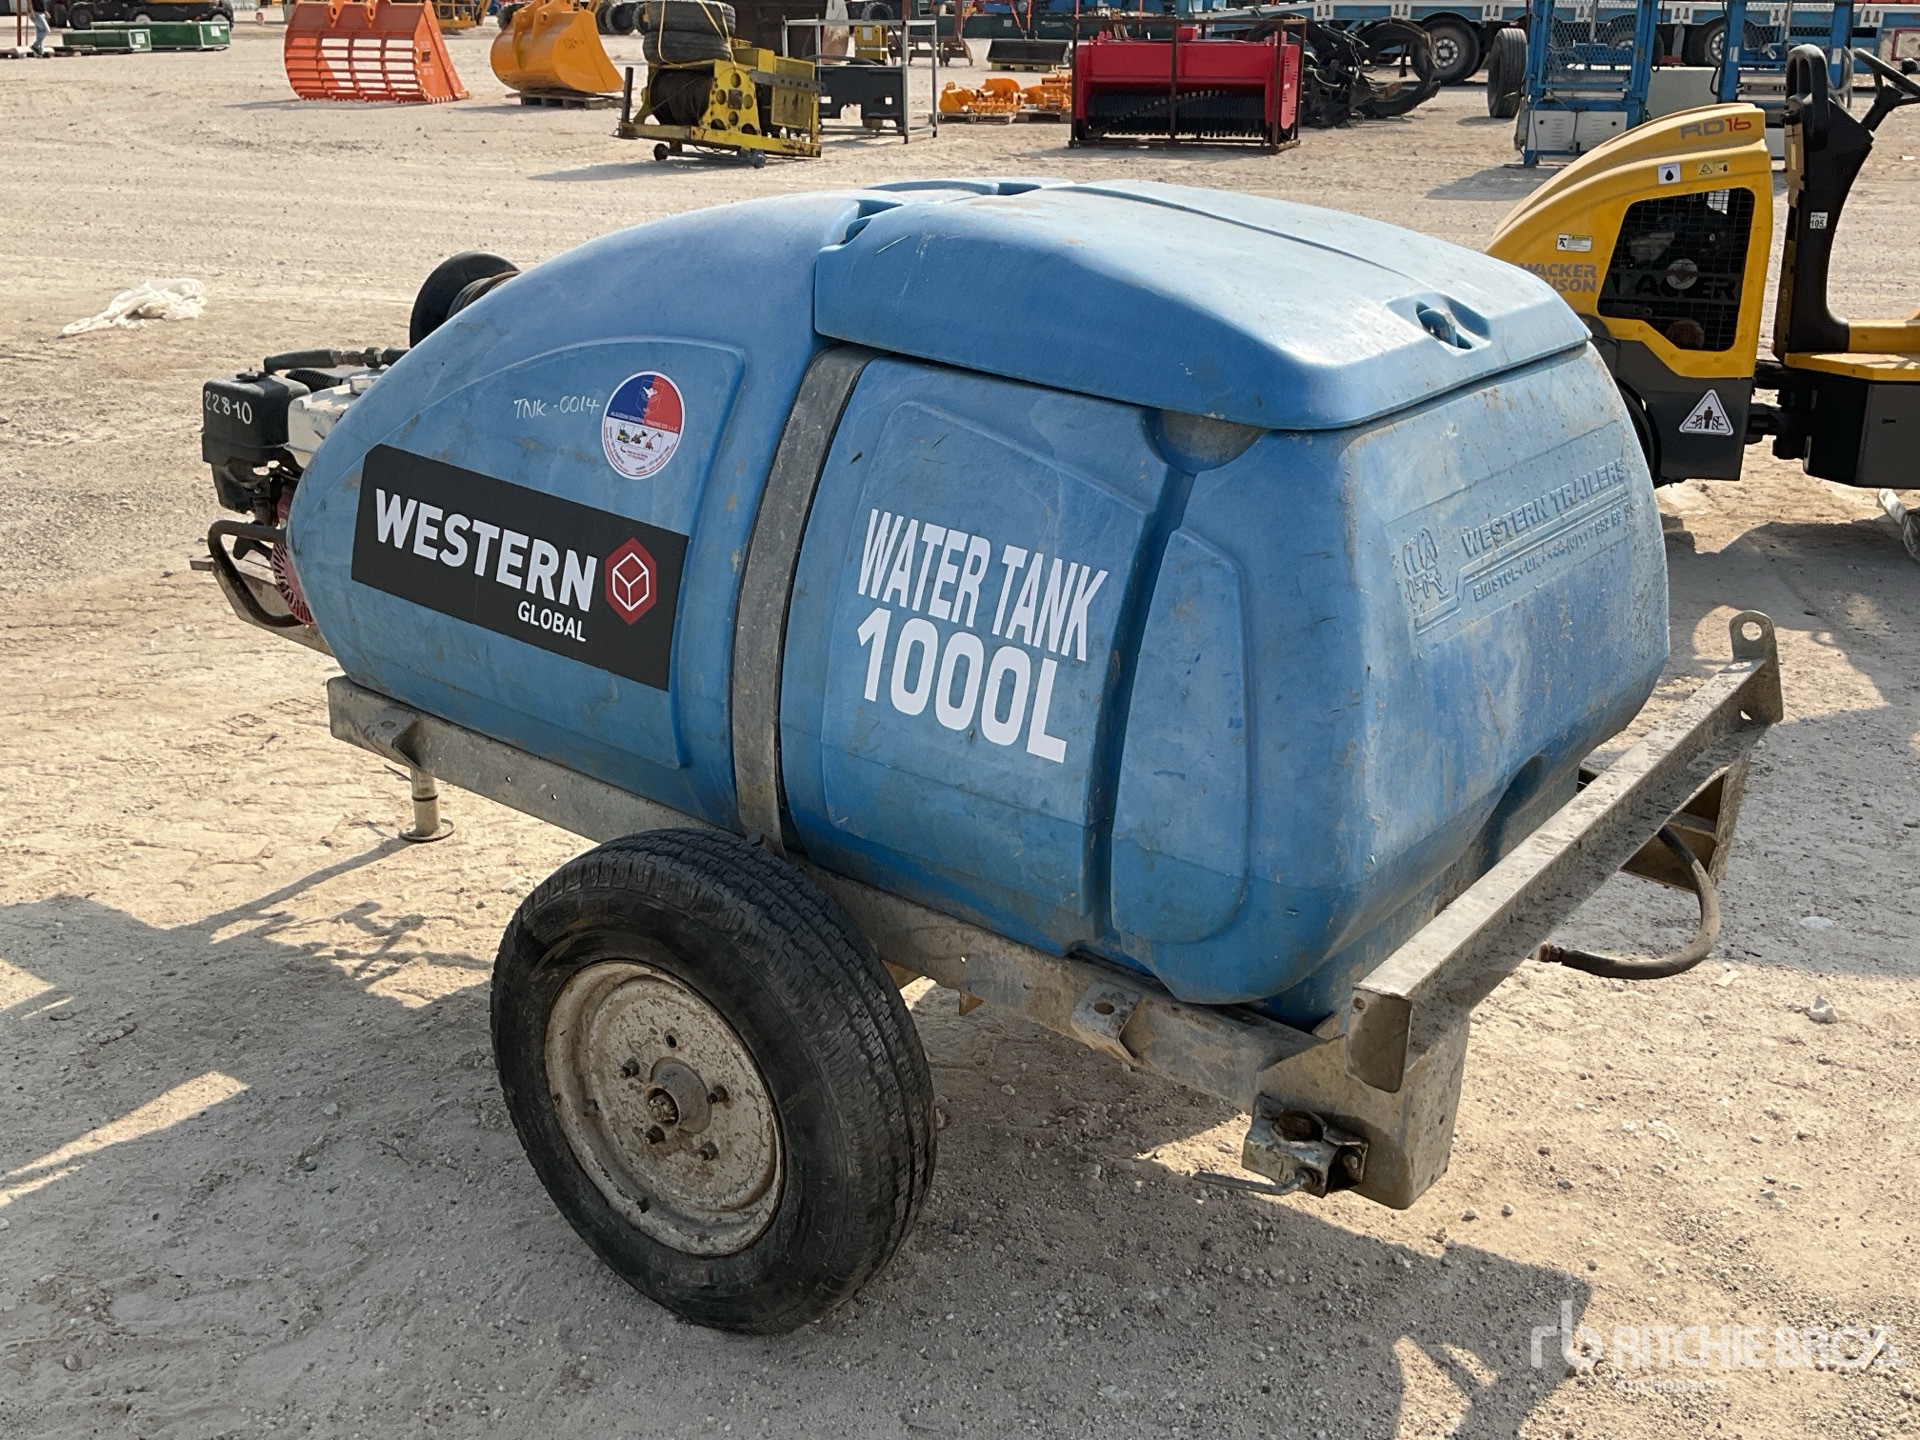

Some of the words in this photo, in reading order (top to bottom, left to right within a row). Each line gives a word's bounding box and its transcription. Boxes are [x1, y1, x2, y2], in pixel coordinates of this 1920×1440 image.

[1680, 117, 1751, 139] RD16
[376, 488, 598, 612] WESTERN
[1461, 494, 1550, 558] WESTERN
[1550, 457, 1627, 514] TRAILERS
[518, 601, 587, 643] GLOBAL
[858, 508, 991, 628] WATER
[992, 545, 1109, 662] TANK
[857, 607, 1067, 764] 1000L
